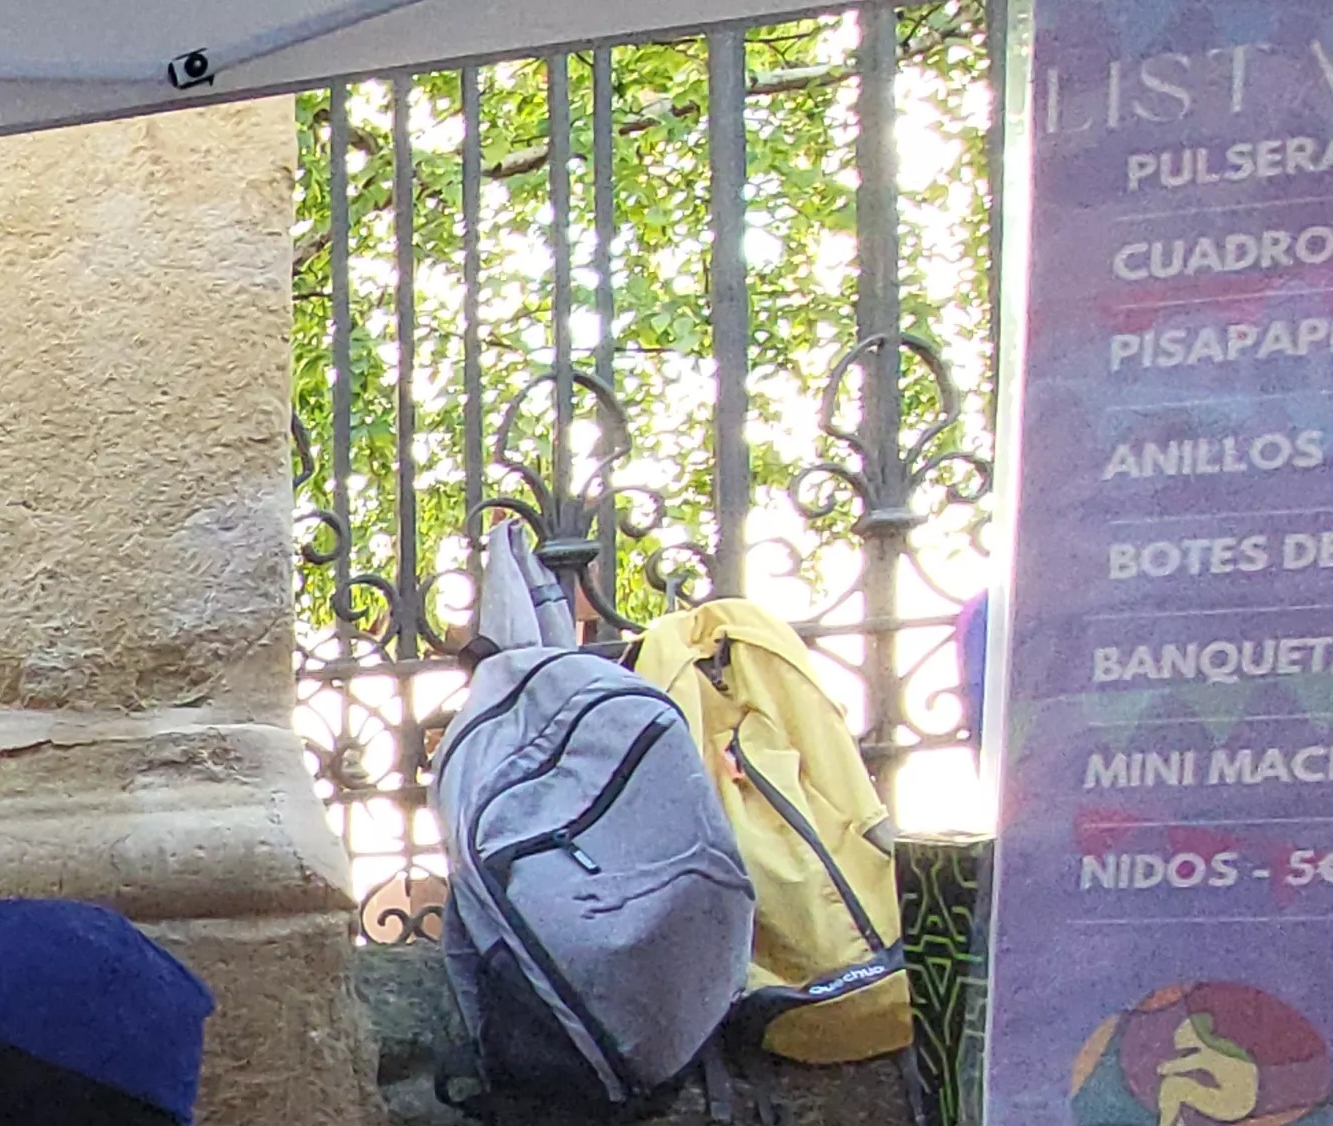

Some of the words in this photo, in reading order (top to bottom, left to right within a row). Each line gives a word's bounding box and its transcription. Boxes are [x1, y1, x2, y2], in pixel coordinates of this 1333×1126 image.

[1100, 428, 1325, 483] ANILLOS
[1107, 534, 1270, 582] BOTES
[1082, 748, 1196, 790] MINI
[1080, 851, 1240, 891] NIDOS
